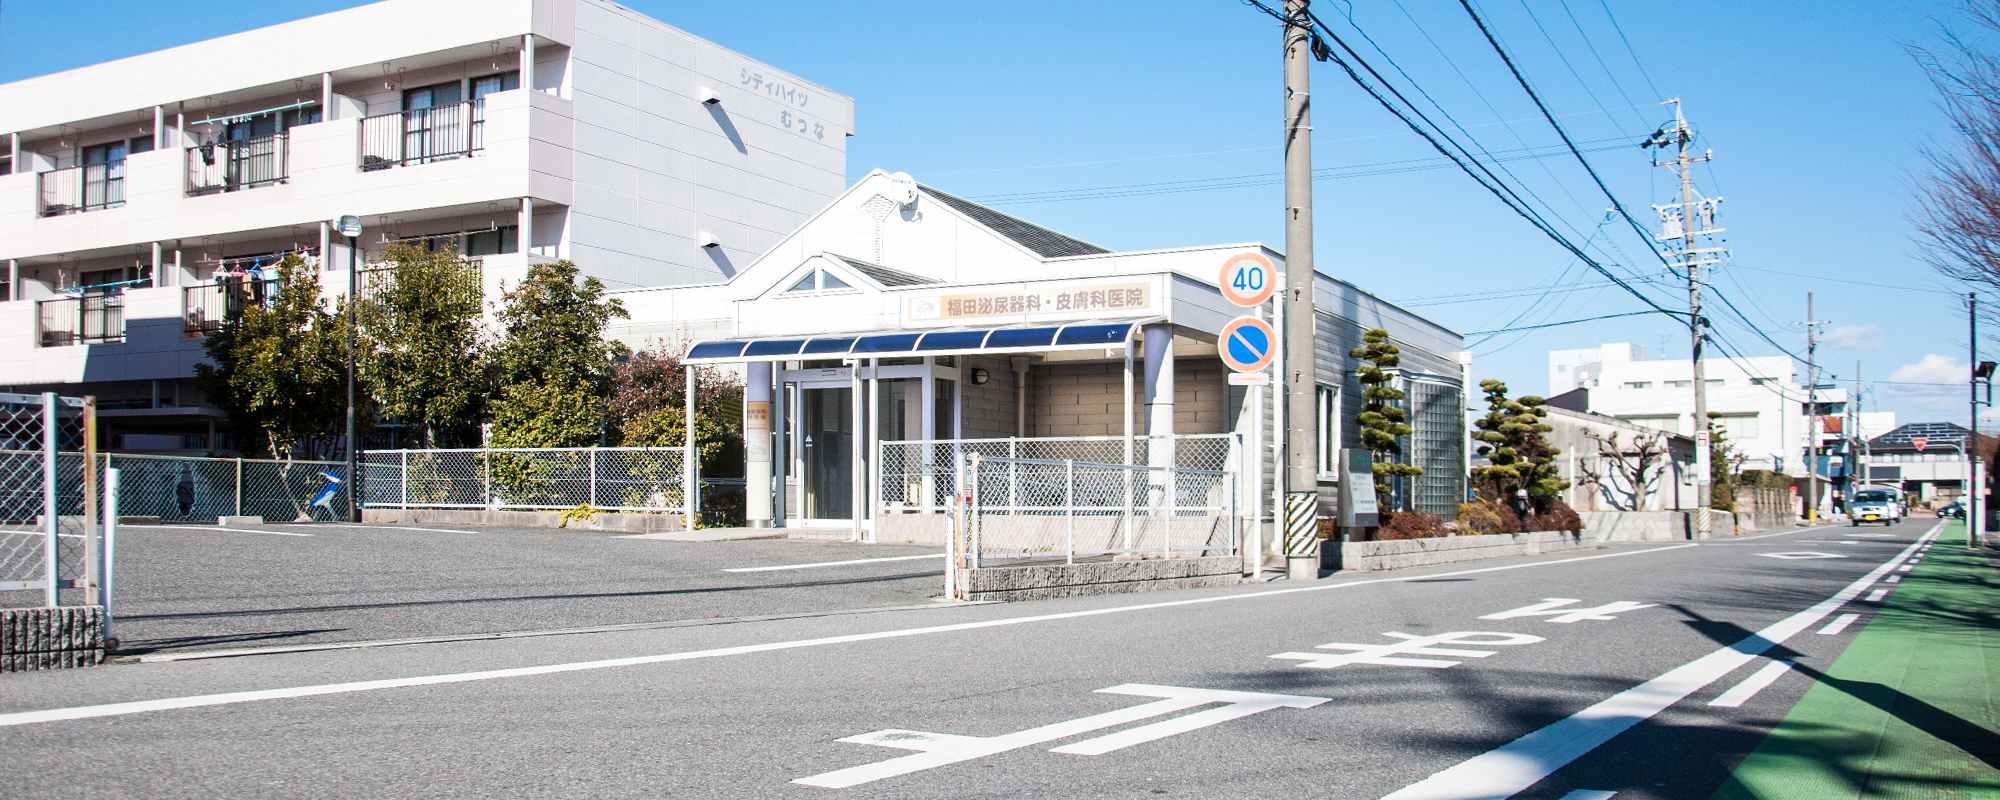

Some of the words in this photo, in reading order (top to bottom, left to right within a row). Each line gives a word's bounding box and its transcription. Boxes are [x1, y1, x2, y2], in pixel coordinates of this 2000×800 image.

[741, 68, 808, 107] シティハイツ
[781, 110, 824, 140] むつな
[1233, 267, 1262, 290] 40
[947, 287, 1143, 316] 福田泌尿器科・皮膚科医院
